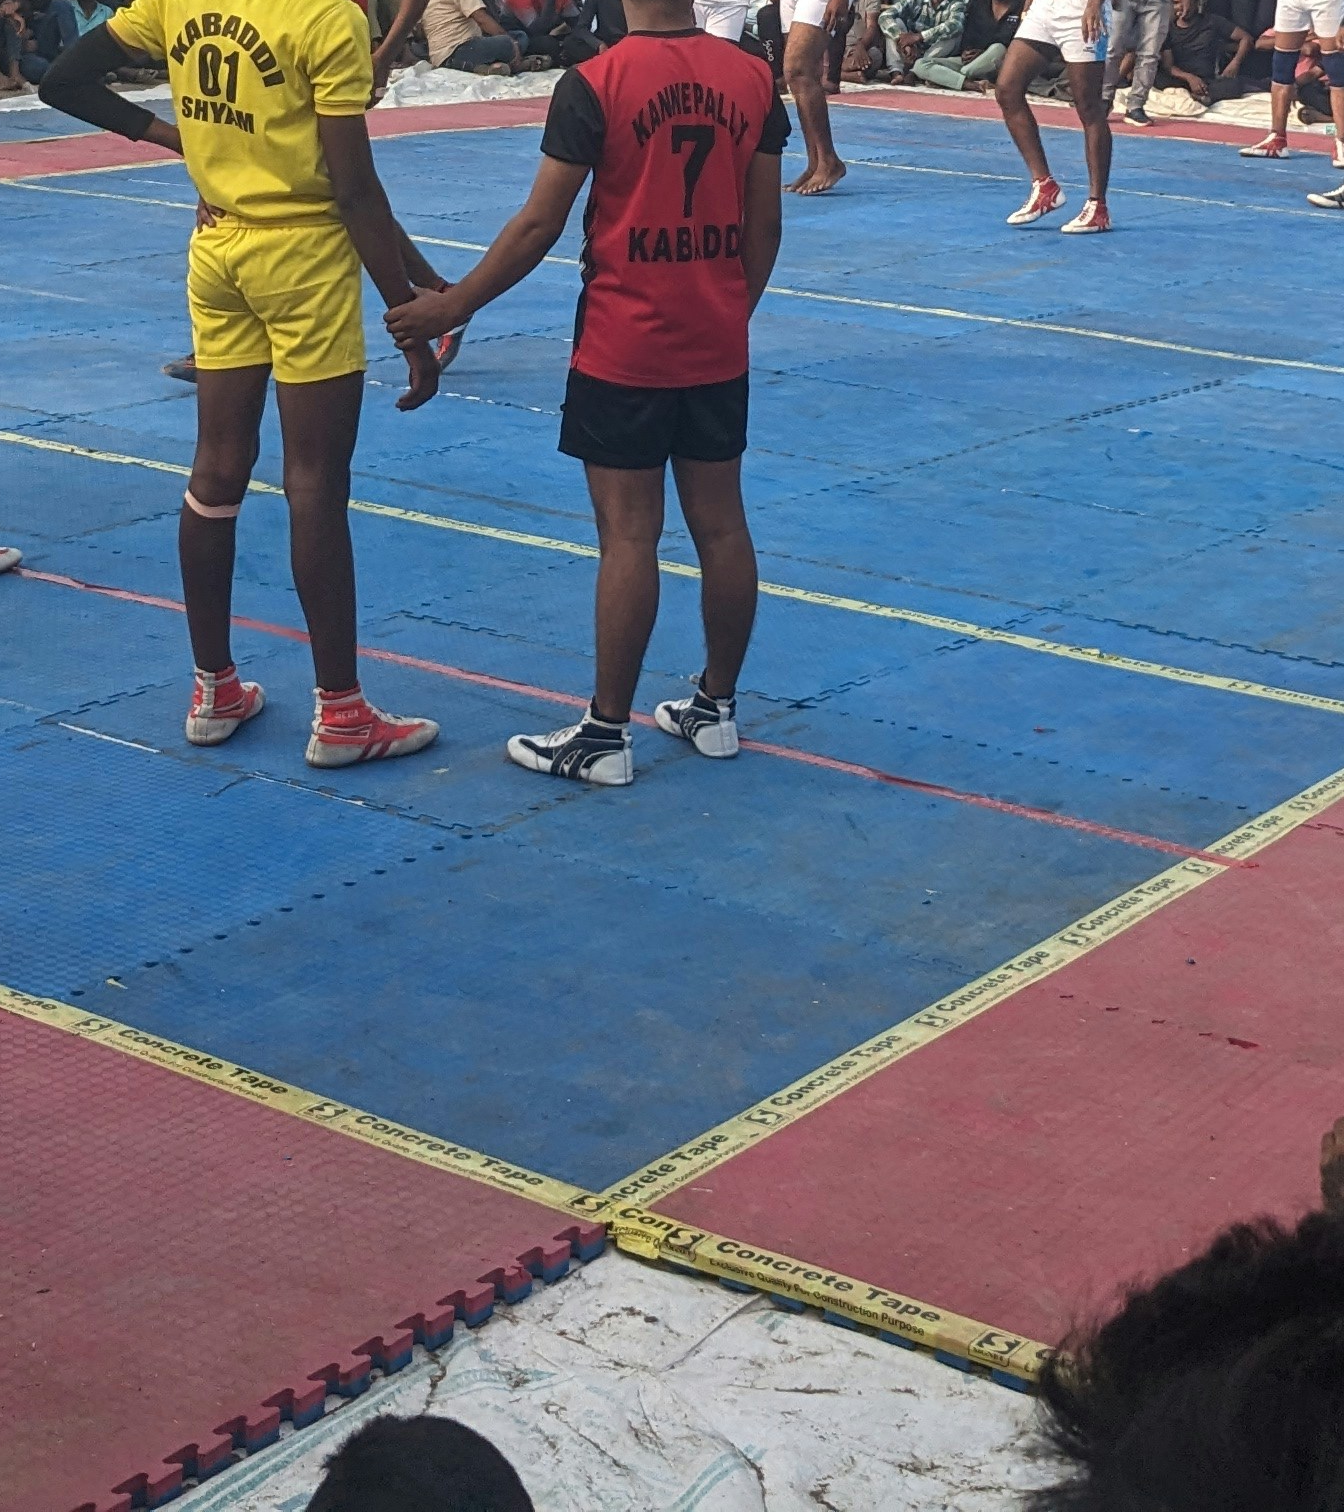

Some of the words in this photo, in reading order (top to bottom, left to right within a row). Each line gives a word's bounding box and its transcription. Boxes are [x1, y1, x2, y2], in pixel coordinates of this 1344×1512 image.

[168, 12, 287, 88] KABADDI
[197, 42, 240, 105] 01
[181, 94, 255, 134] SHYAM
[630, 82, 750, 148] KANNEPALLY
[670, 124, 715, 219] 7
[627, 224, 742, 263] KABADD
[1247, 814, 1284, 831] Tape
[1077, 896, 1144, 931] Concrete
[1135, 877, 1175, 896] Tape
[936, 972, 1013, 1012] Concrete
[1004, 950, 1050, 972] Tape
[118, 1029, 223, 1070] Concrete
[230, 1067, 289, 1094] Tape
[770, 1060, 858, 1107] Concrete
[850, 1034, 902, 1058] Tape
[355, 1115, 472, 1161] Concrete
[479, 1157, 544, 1186] Tape
[669, 1134, 729, 1161] Tape
[709, 1257, 755, 1279] Exclusive
[756, 1272, 793, 1291] Quality
[813, 1291, 879, 1321] Construction
[880, 1312, 925, 1336] Purpose
[716, 1240, 854, 1292] Concrete
[865, 1287, 941, 1322] Tape
